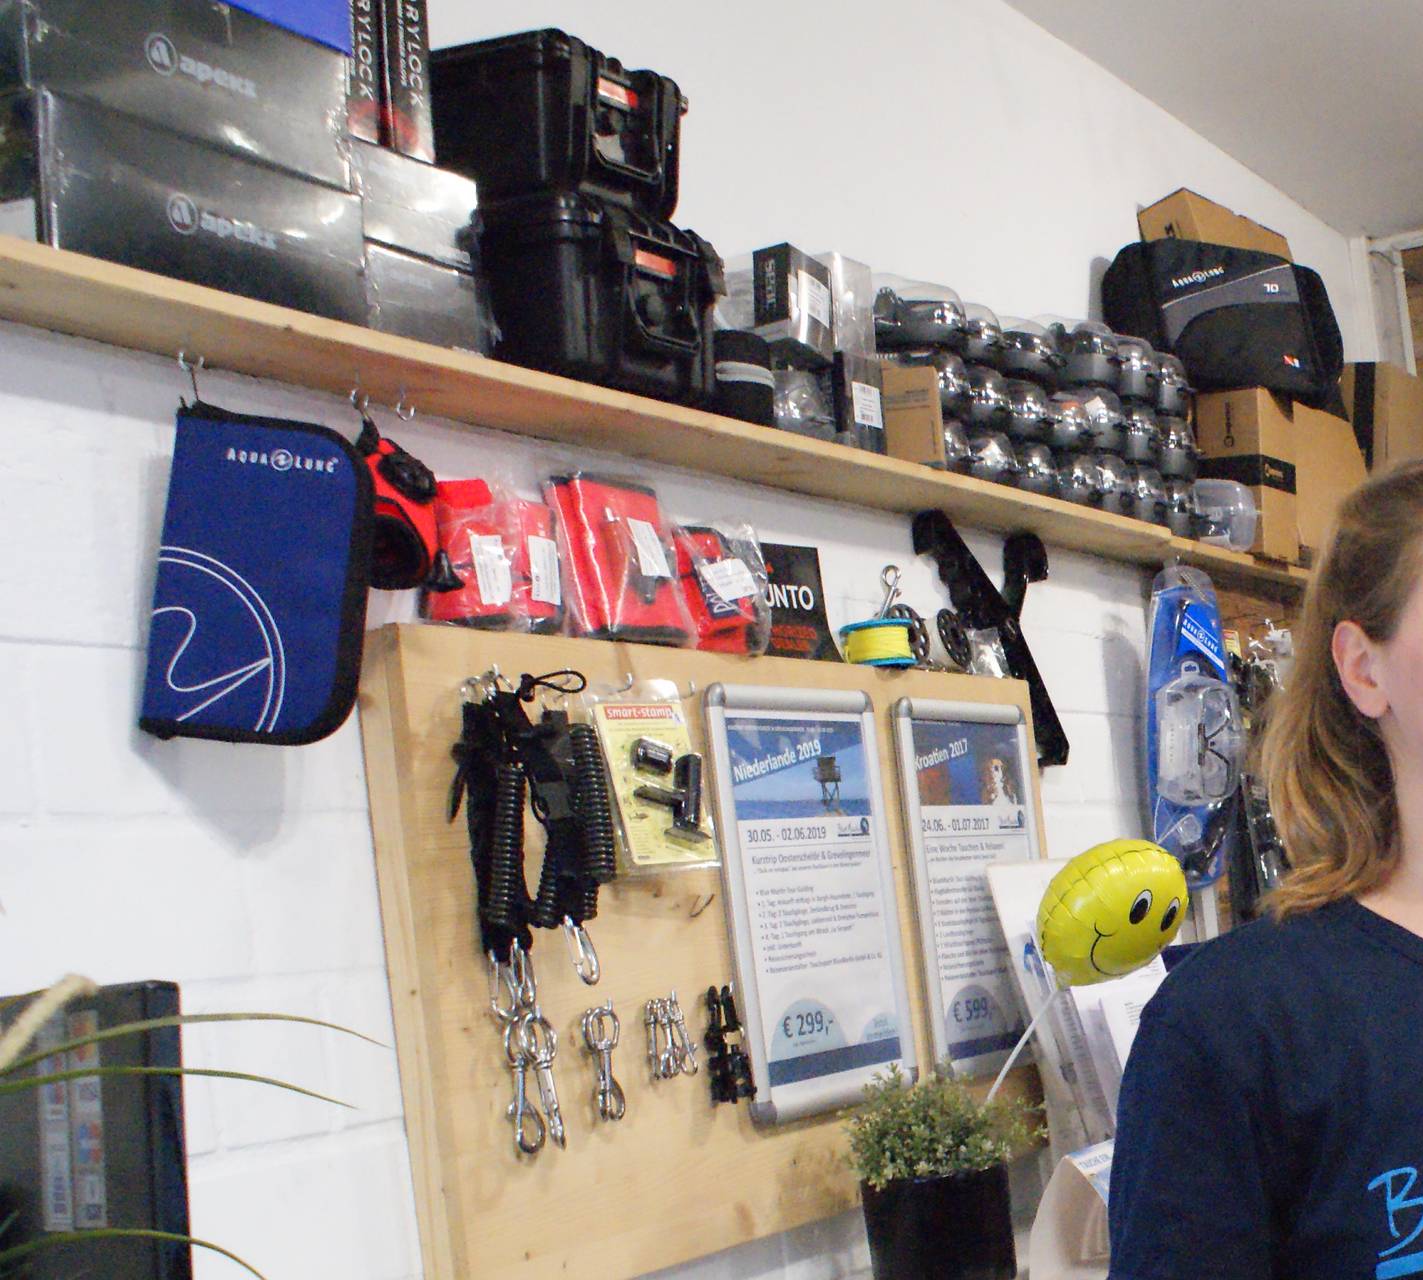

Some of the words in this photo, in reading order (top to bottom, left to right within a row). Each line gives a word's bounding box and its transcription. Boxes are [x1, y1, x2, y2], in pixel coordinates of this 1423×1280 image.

[226, 447, 268, 466] AQUA
[294, 455, 335, 474] LUNG
[606, 707, 673, 719] smart-stamp
[949, 738, 968, 758] 2017
[733, 751, 797, 782] Niederlande
[798, 739, 822, 760] 2019
[747, 829, 774, 843] 30.05.
[781, 826, 827, 841] 02.06.2019
[952, 818, 989, 832] 01.07.2017
[783, 1016, 793, 1038] €
[796, 1011, 834, 1036] 299,-
